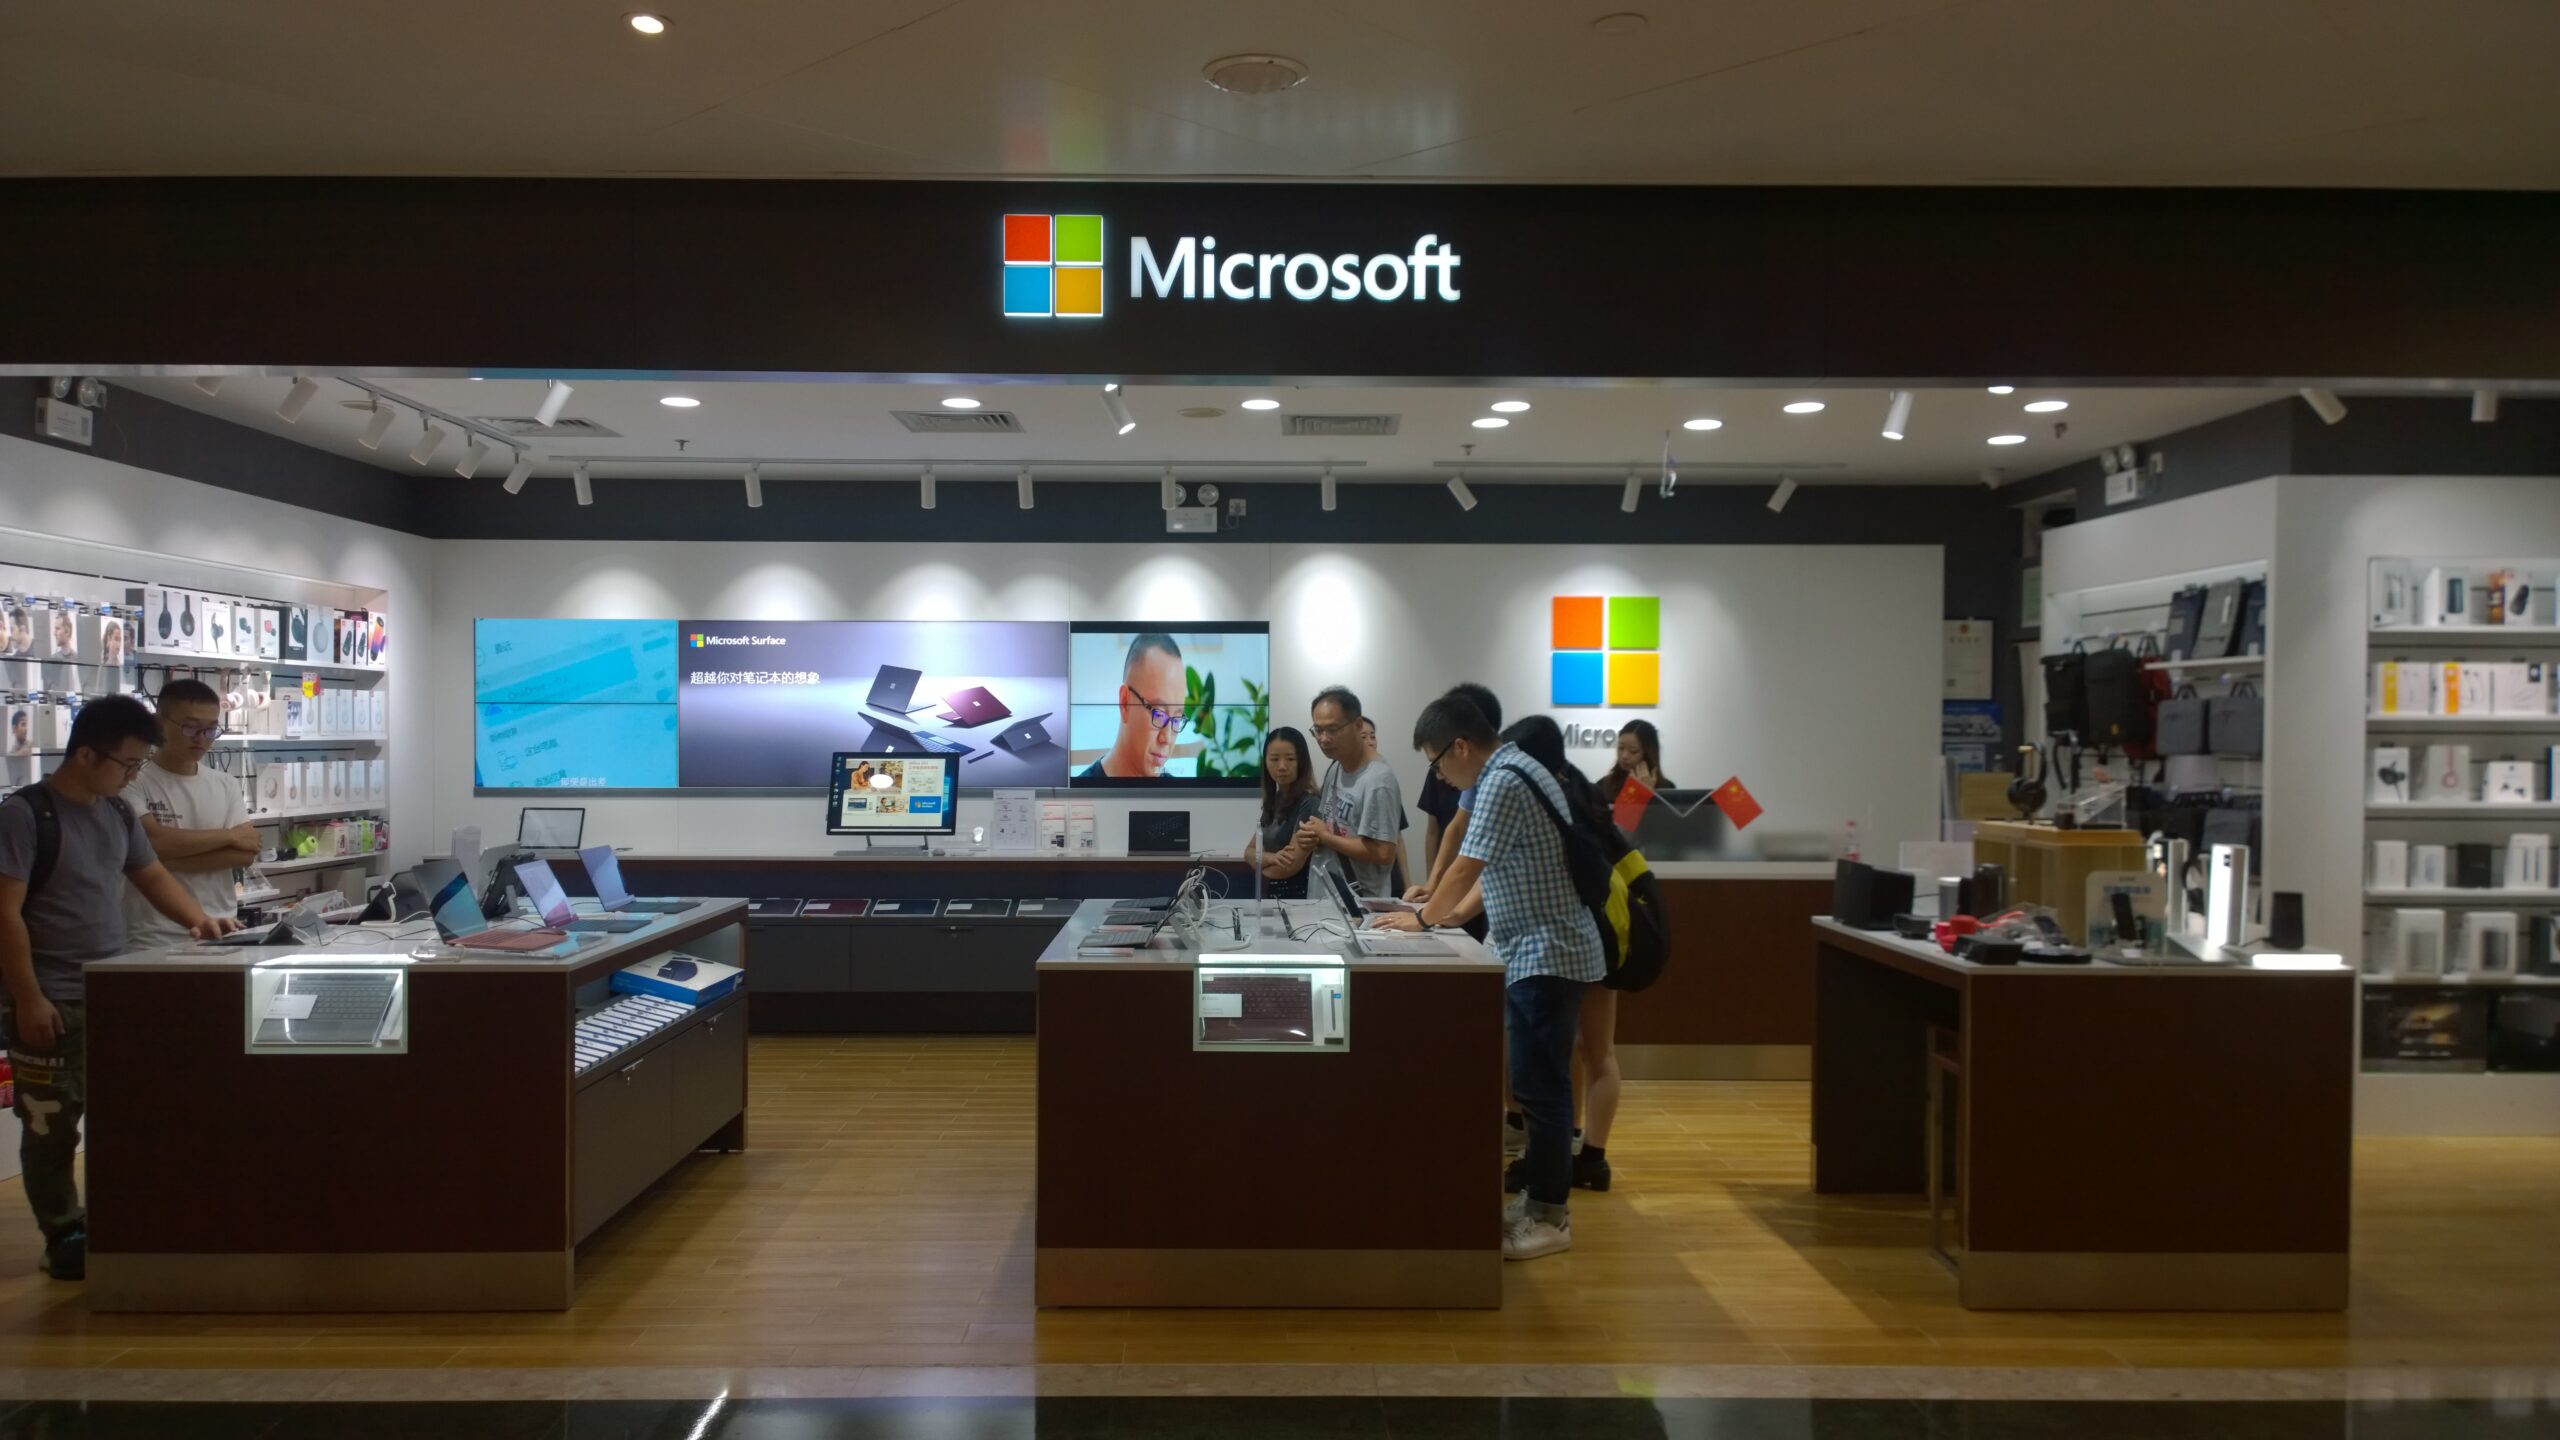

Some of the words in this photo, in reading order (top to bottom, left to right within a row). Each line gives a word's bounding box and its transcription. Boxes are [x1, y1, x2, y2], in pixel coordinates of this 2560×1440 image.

[1130, 234, 1461, 301] Microsoft
[706, 636, 749, 646] Microsoft
[751, 636, 787, 646] Surface
[690, 671, 820, 685] 超越你对笔记本的想象
[1562, 723, 1619, 748] Micro
